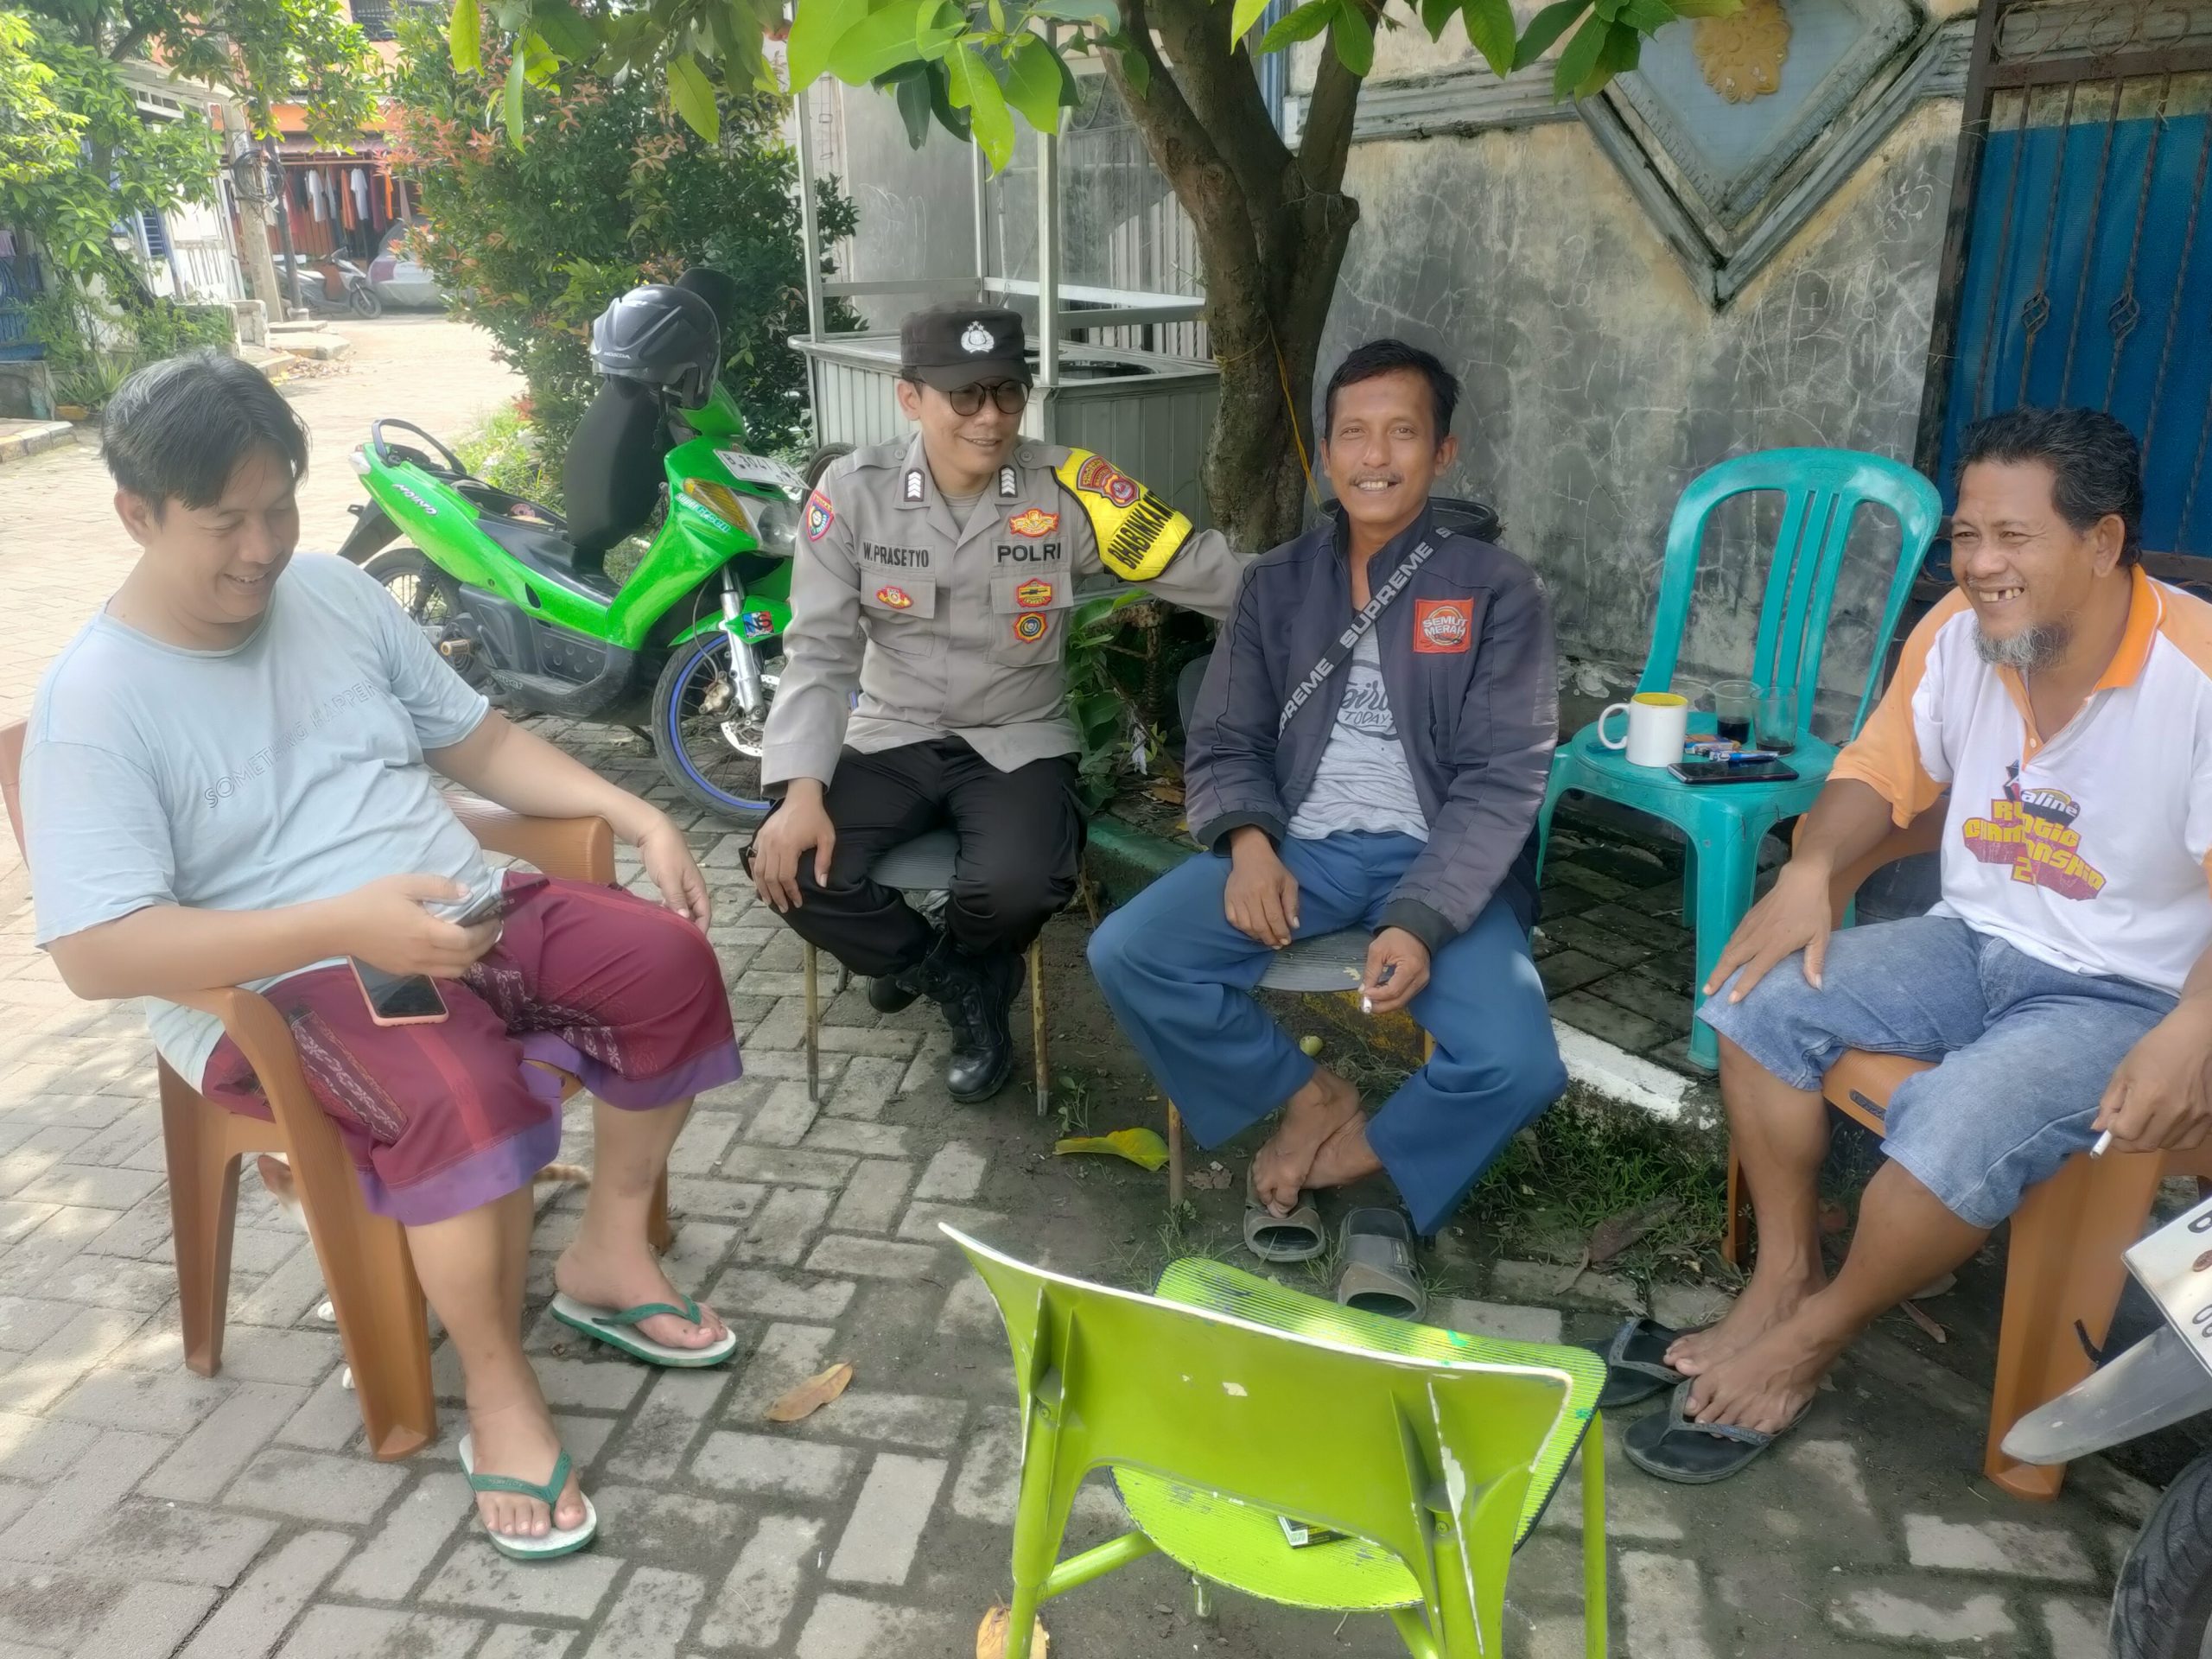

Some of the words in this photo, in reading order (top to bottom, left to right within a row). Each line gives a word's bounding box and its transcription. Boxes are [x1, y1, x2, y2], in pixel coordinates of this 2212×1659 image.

[997, 543, 1062, 563] POLRI
[1339, 541, 1434, 649] SUPREME
[1422, 616, 1469, 628] SEMUT
[1424, 624, 1466, 638] MERAH
[1279, 658, 1335, 741] PREME
[1344, 710, 1390, 725] TODAY
